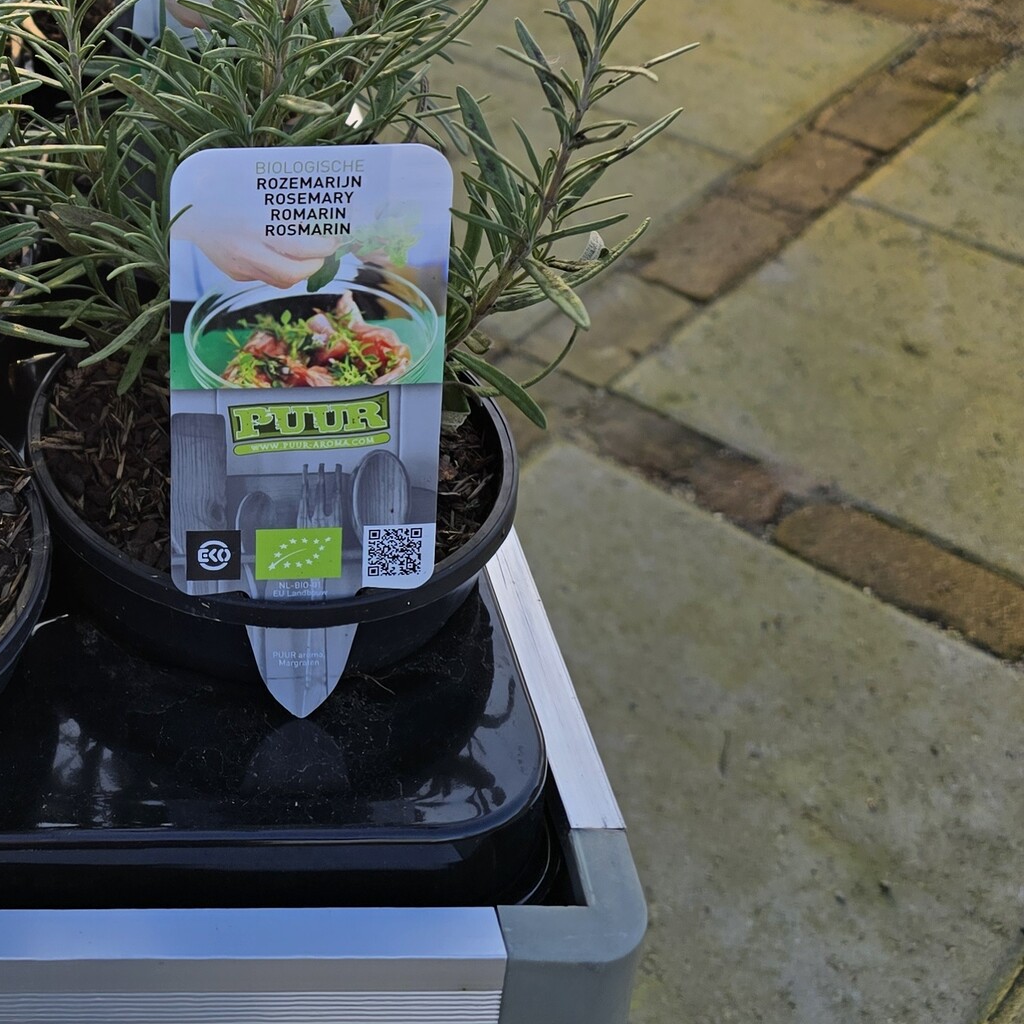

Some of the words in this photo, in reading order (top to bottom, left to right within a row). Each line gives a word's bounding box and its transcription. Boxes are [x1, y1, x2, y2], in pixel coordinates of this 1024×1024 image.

[256, 159, 365, 175] BIOLOGISCHE
[256, 176, 362, 190] ROZEMARIJN
[264, 191, 354, 206] ROSEMARY
[271, 207, 346, 221] ROMARIN
[265, 222, 350, 236] ROSMARIN
[232, 400, 388, 440] PUUR
[197, 546, 231, 565] EKO
[272, 589, 285, 598] EU
[272, 650, 296, 658] PUUR
